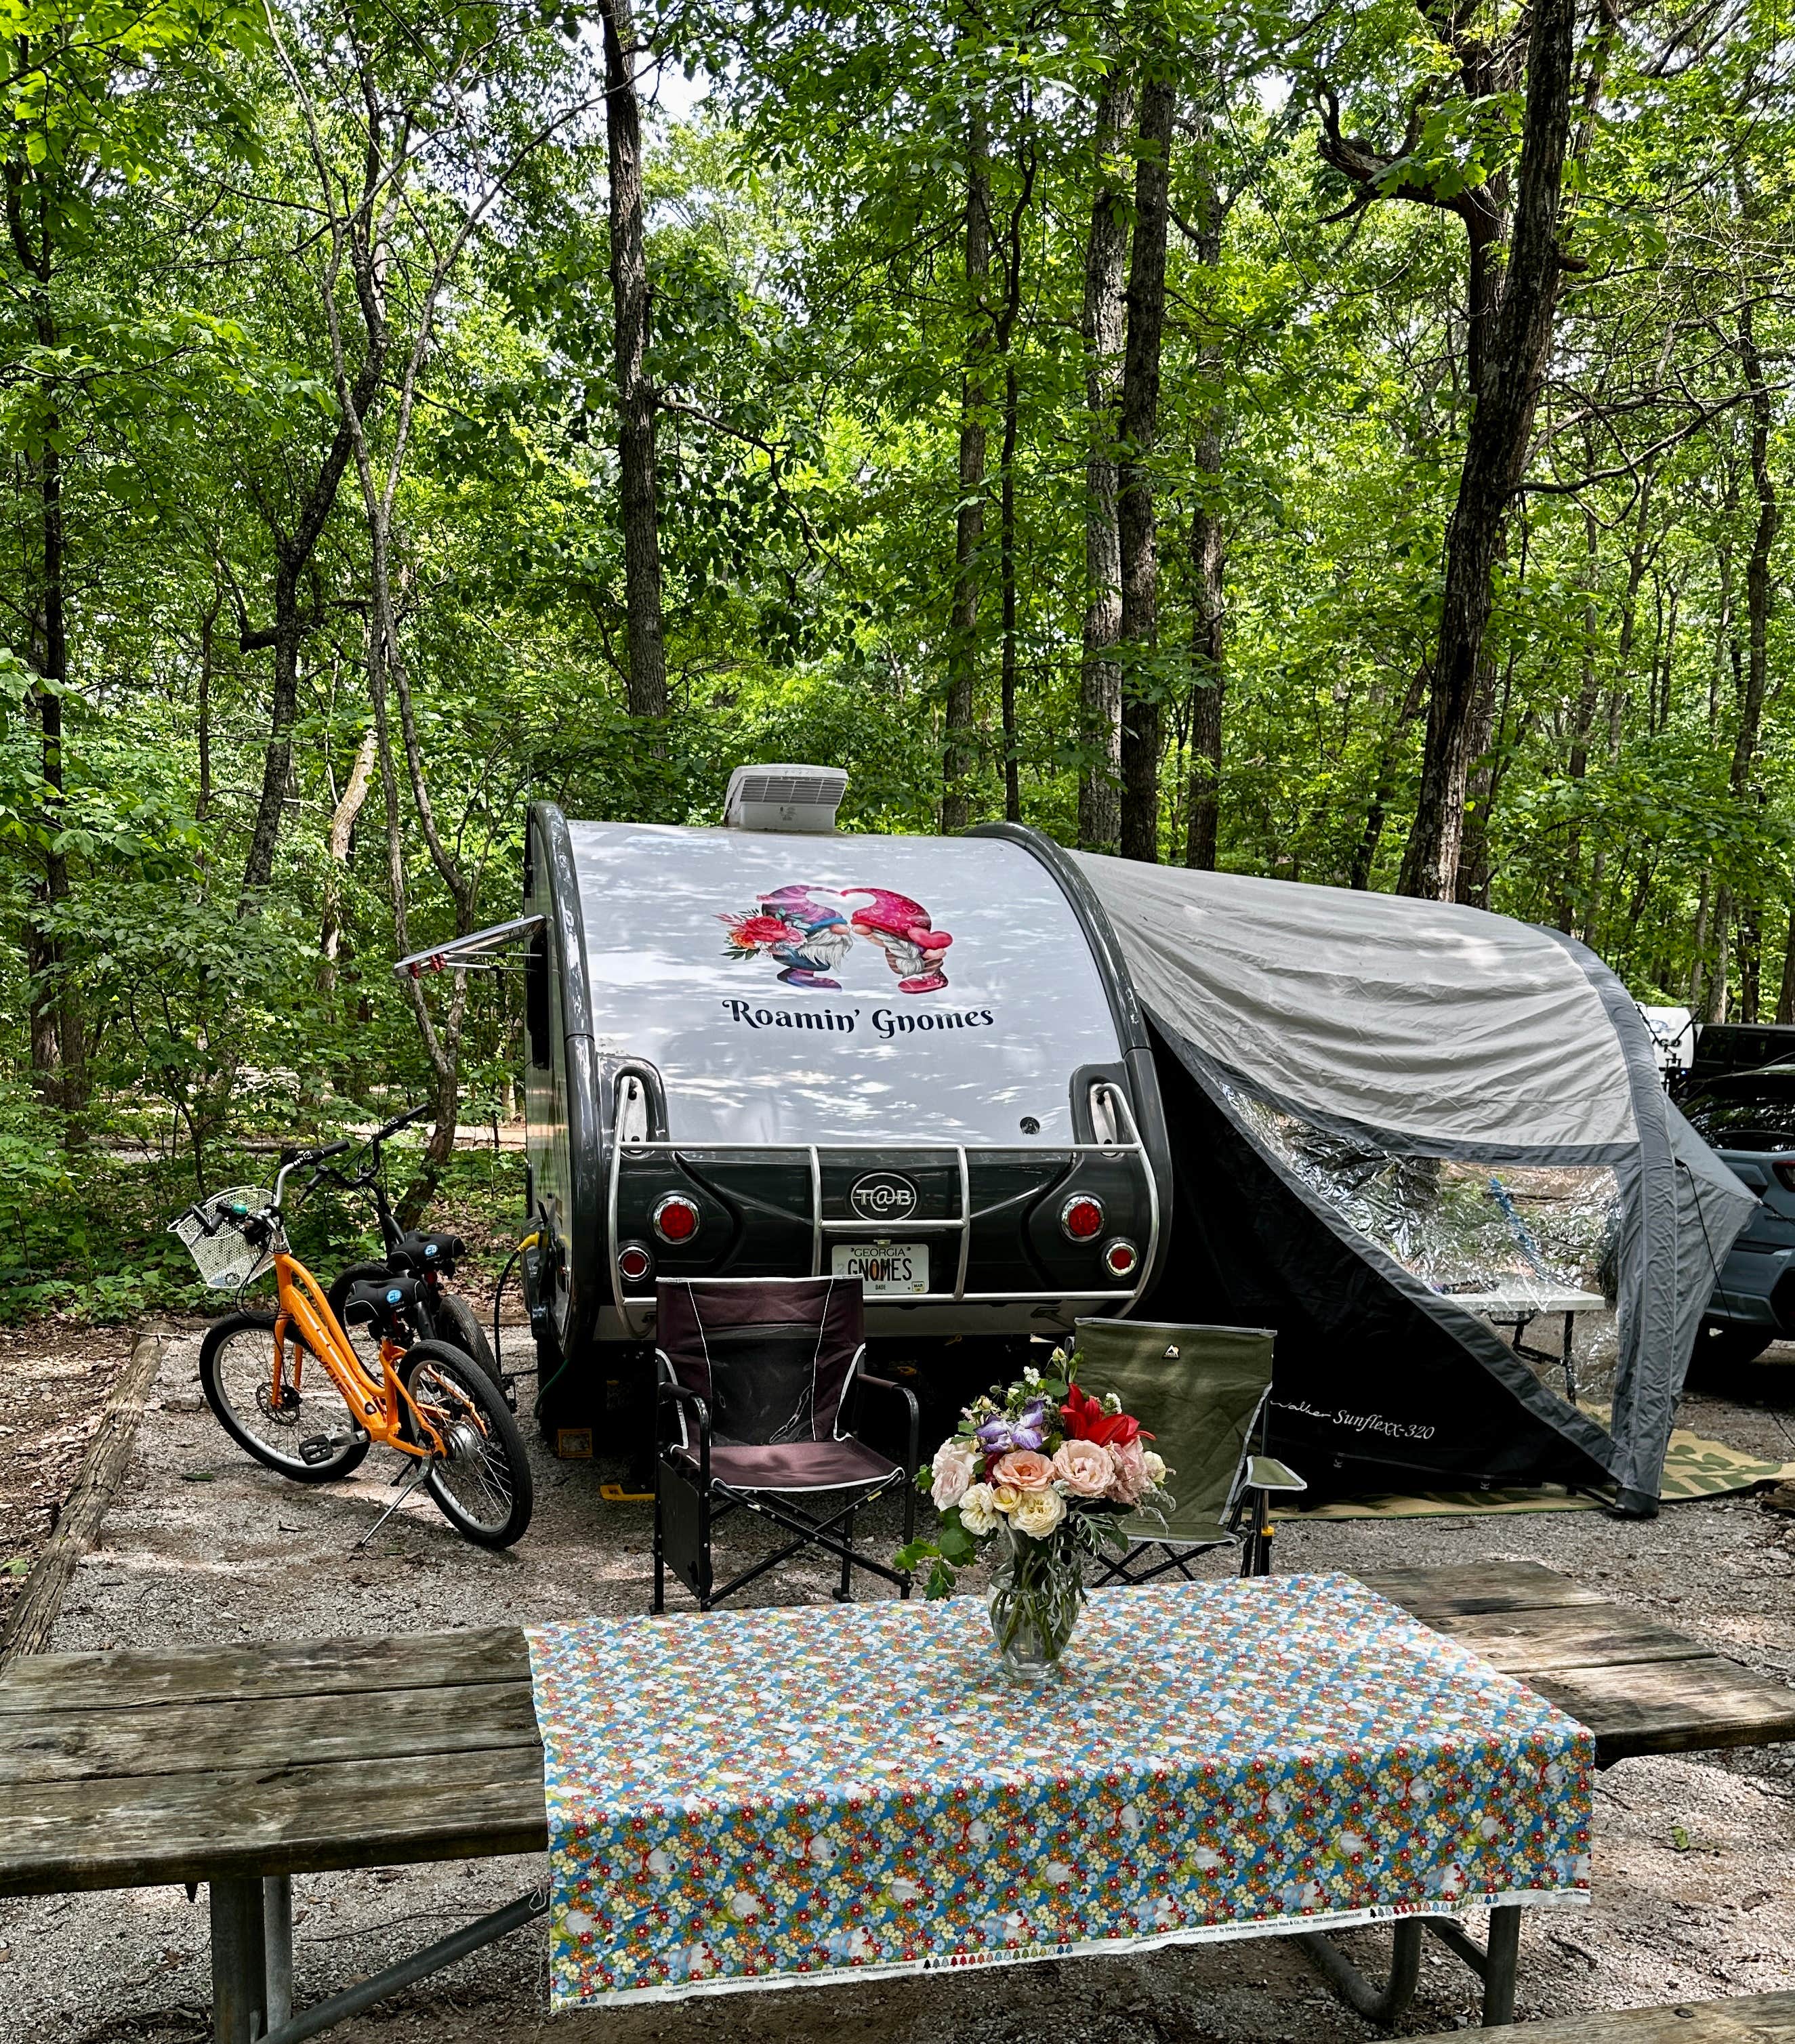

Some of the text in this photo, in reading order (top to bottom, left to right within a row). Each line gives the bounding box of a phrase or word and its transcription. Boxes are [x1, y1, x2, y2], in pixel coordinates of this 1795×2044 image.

[722, 999, 994, 1039] Roamin' Gnomes
[856, 1185, 911, 1212] T@B
[854, 1248, 905, 1257] GEORGIA
[848, 1258, 912, 1282] GNOMES
[1333, 1409, 1435, 1440] Sunflexx-320
